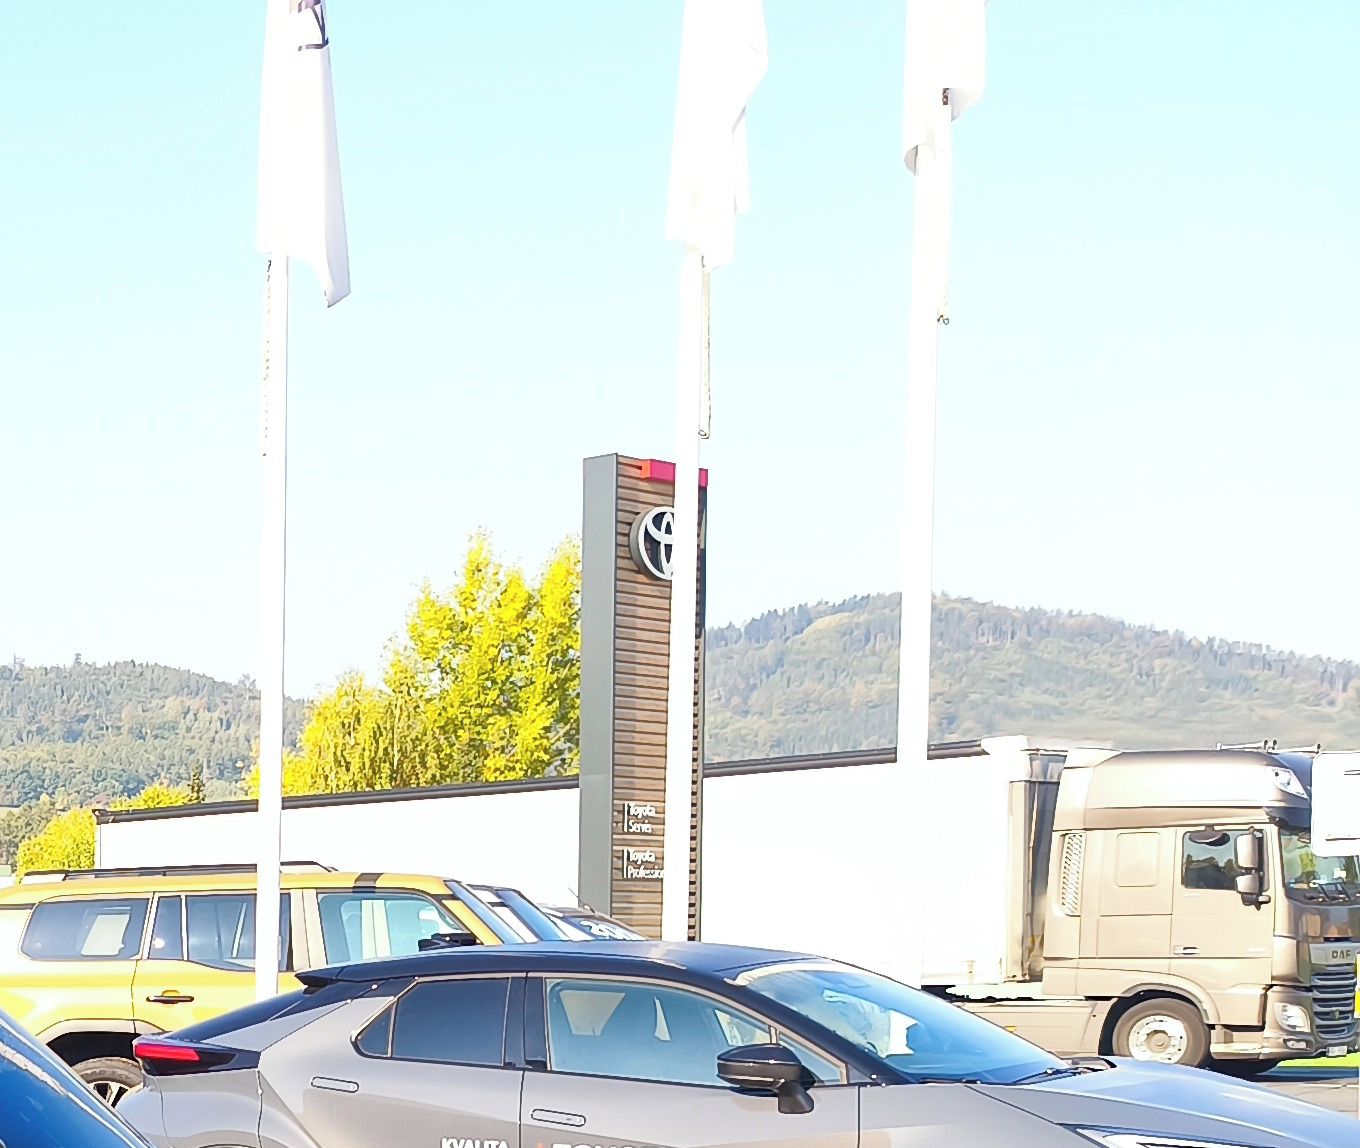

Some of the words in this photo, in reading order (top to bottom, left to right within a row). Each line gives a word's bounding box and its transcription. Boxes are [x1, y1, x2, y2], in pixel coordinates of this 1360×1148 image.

[629, 803, 656, 818] Toyota
[628, 848, 656, 864] Toyota
[1331, 949, 1351, 959] DAF
